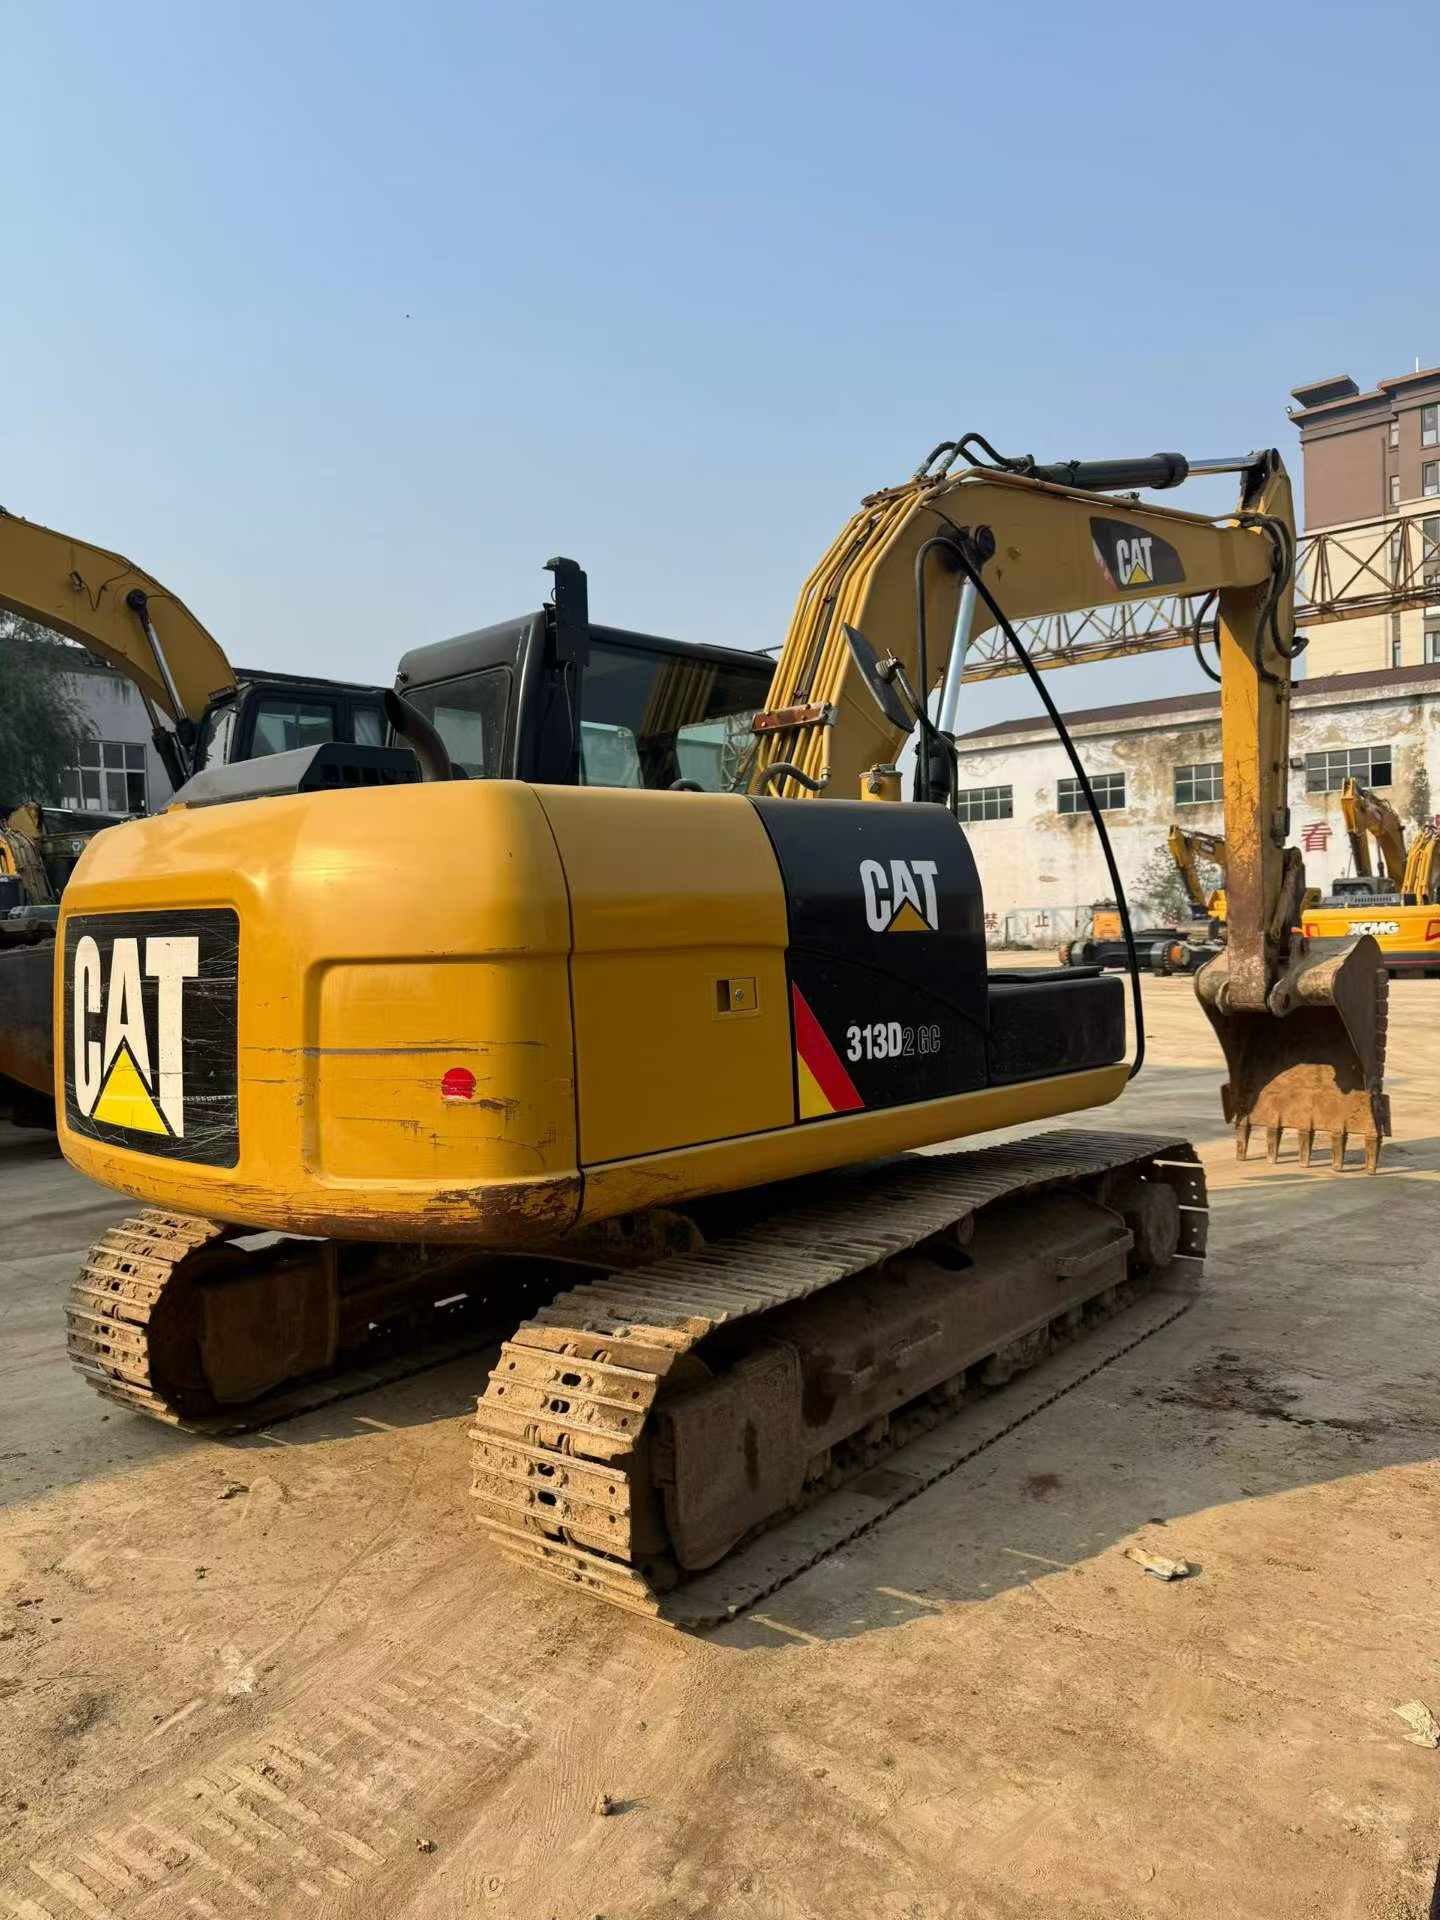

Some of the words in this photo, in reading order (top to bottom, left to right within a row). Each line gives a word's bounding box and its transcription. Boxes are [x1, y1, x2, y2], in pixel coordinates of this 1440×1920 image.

[1116, 537, 1153, 585] CAT
[1301, 822, 1333, 852] 看
[859, 859, 938, 932] CAT
[1346, 921, 1400, 936] XCMG
[74, 935, 199, 1138] CAT
[846, 1022, 915, 1062] 313D2
[917, 1025, 941, 1055] GC
